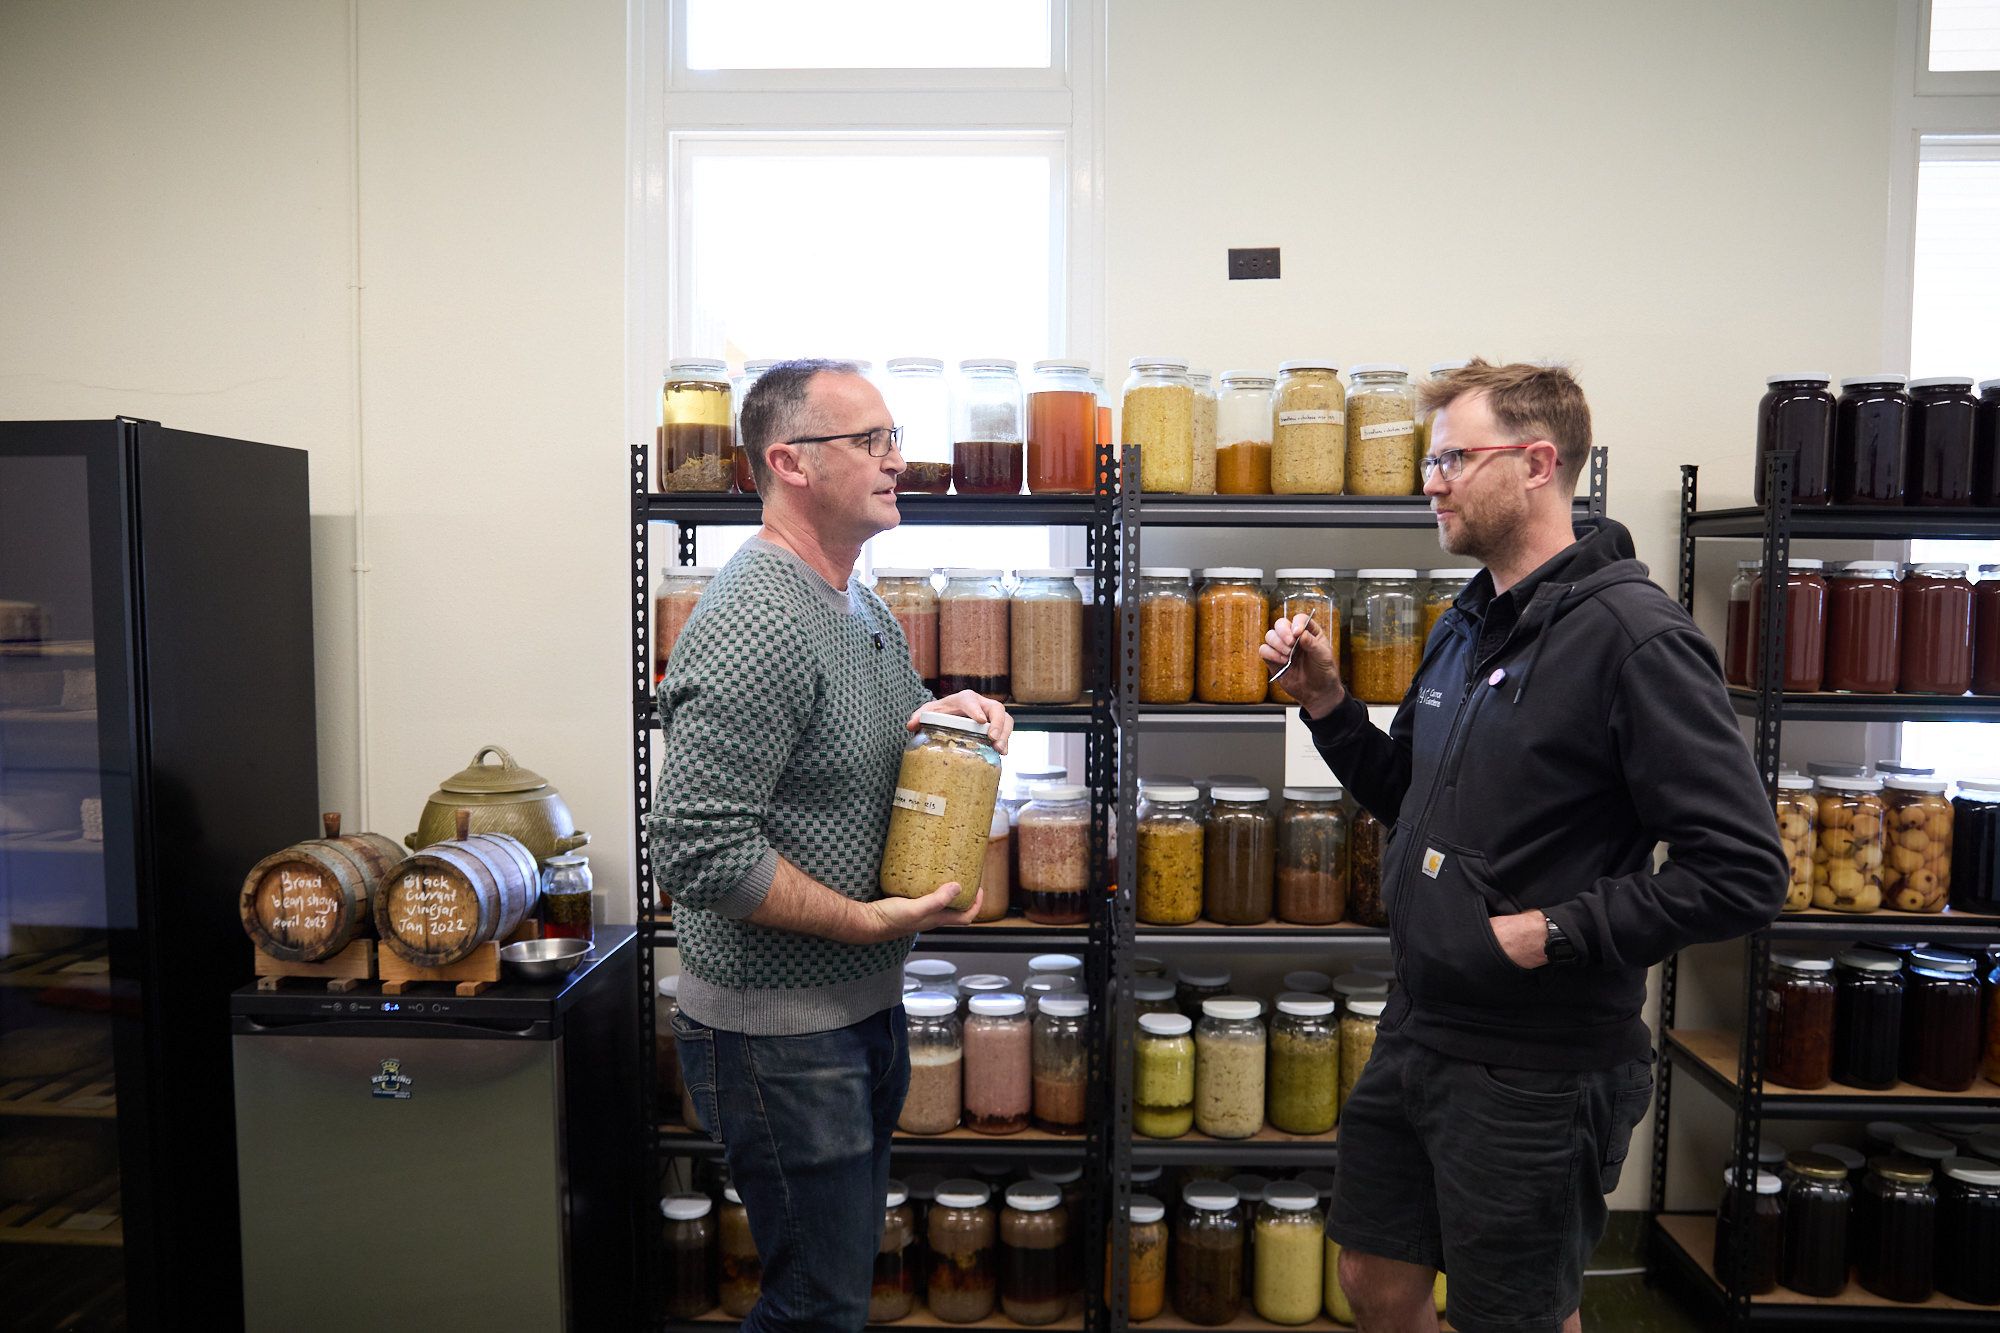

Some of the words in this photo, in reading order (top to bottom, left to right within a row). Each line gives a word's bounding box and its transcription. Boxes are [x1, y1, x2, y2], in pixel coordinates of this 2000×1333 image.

[281, 871, 322, 894] Broad
[403, 875, 449, 890] Black
[271, 894, 304, 912] bean
[398, 917, 424, 935] Jan
[430, 918, 467, 935] 2022
